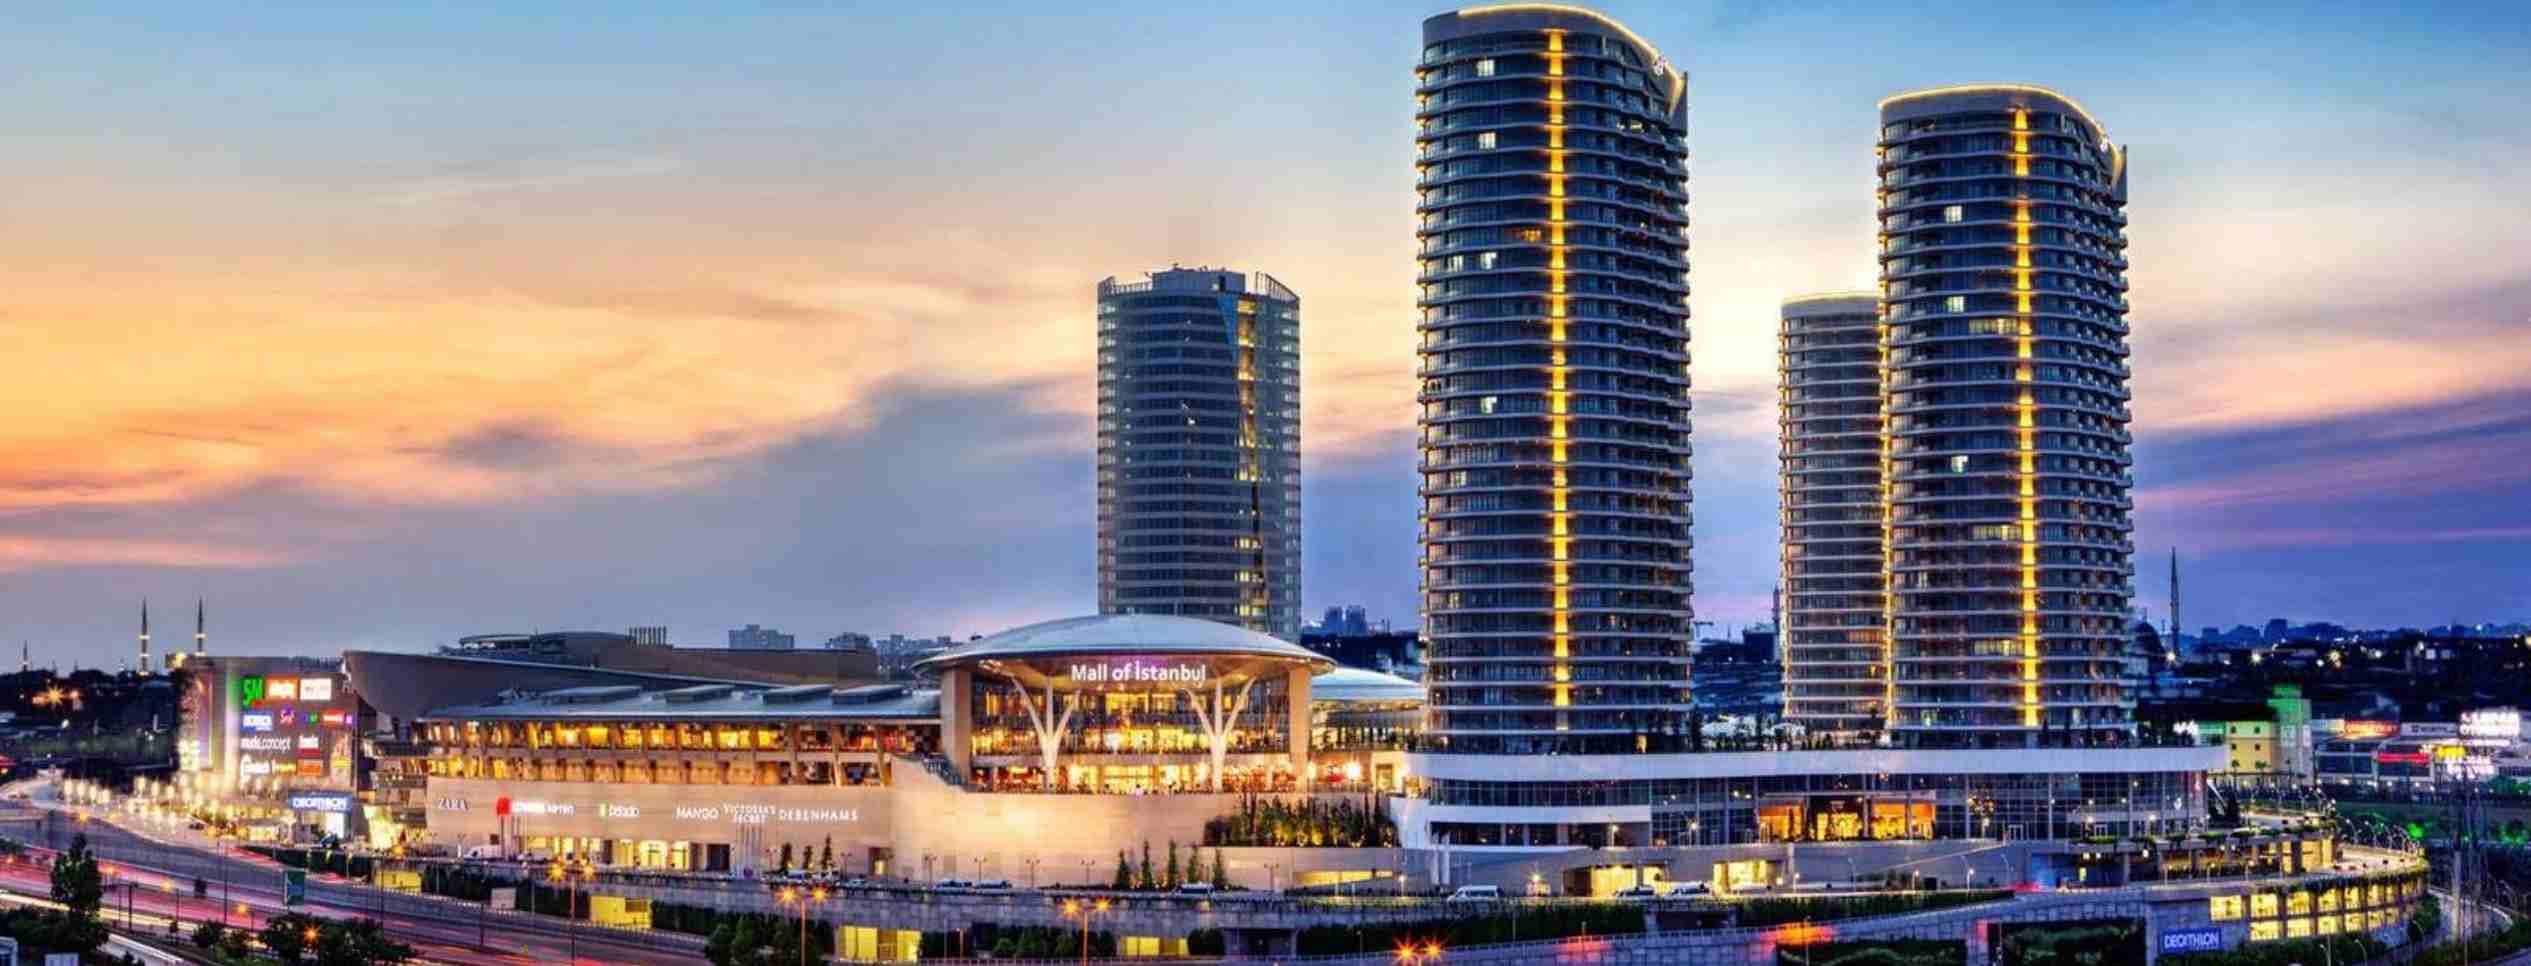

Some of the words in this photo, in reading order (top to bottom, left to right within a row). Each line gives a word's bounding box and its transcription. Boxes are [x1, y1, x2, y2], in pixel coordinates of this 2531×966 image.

[1071, 664, 1108, 681] Mall
[1112, 662, 1132, 681] of
[676, 806, 719, 820] MANGO
[779, 808, 858, 822] DEBENHAMS
[2164, 932, 2219, 949] DECATHLON
